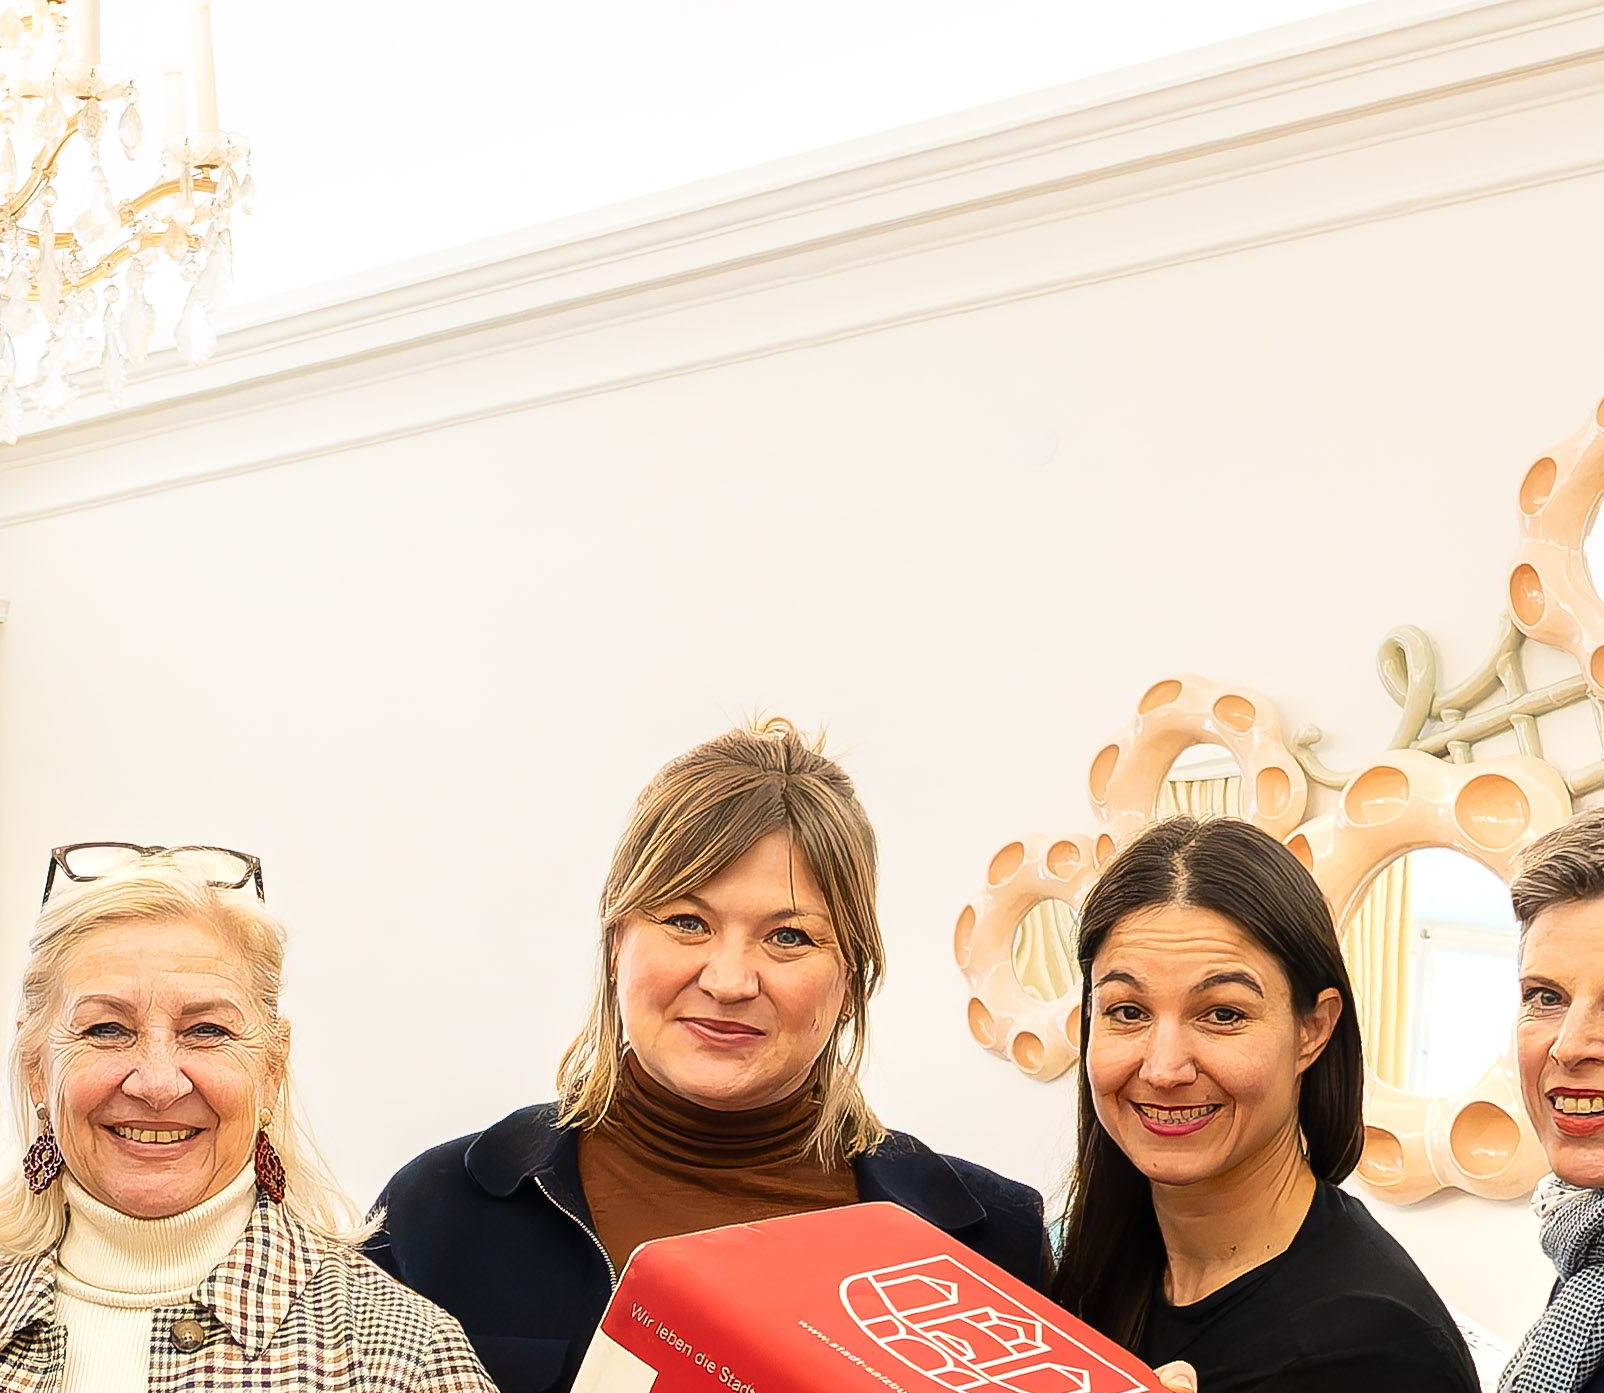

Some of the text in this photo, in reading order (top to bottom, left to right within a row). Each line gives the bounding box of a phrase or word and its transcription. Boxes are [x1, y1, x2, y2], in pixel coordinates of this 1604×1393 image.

[631, 1302, 654, 1328] Wir
[655, 1322, 693, 1357] leben
[694, 1352, 717, 1373] die
